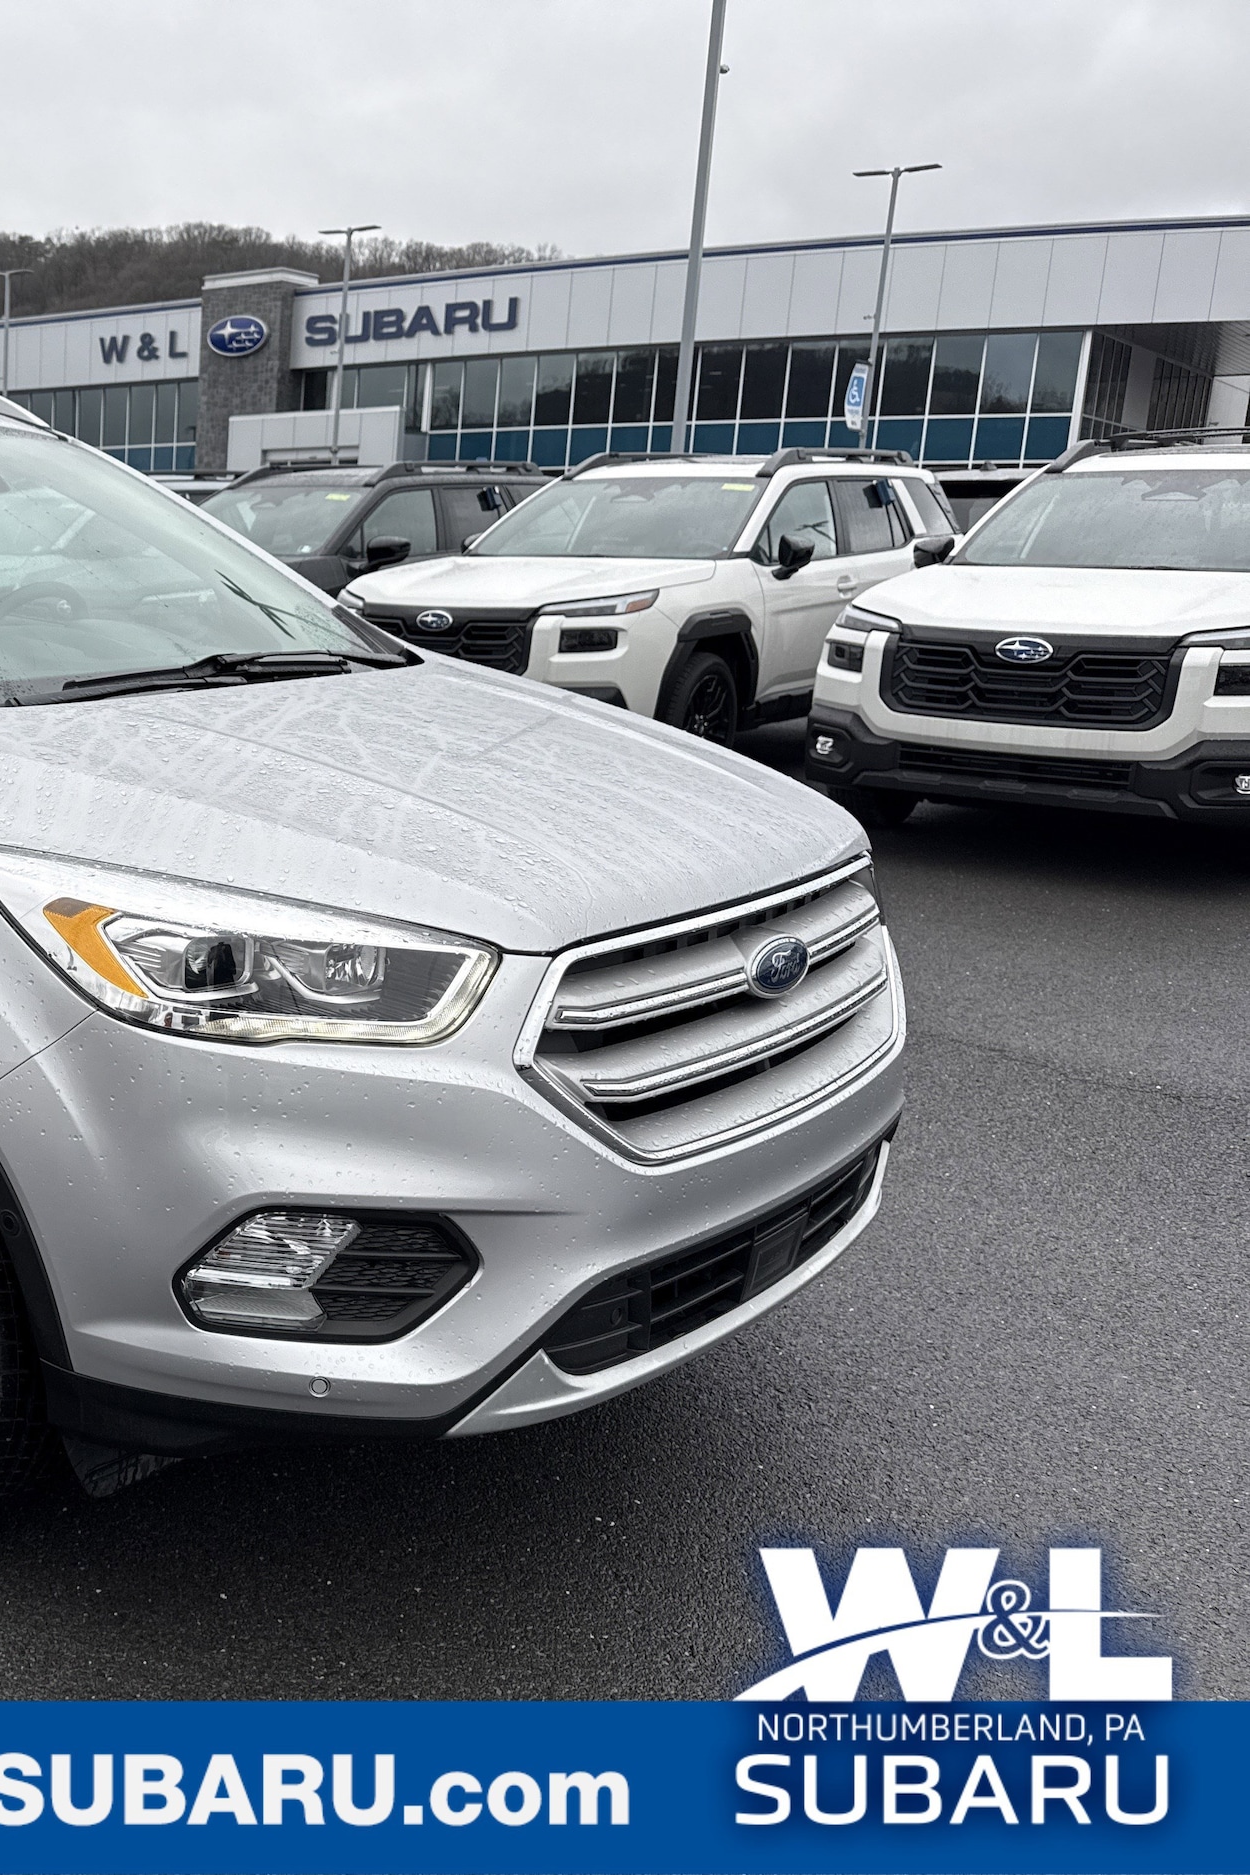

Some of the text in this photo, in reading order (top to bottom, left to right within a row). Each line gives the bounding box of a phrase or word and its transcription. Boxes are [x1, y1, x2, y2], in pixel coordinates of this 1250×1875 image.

[304, 296, 520, 348] SUBARU
[99, 329, 189, 364] W & L
